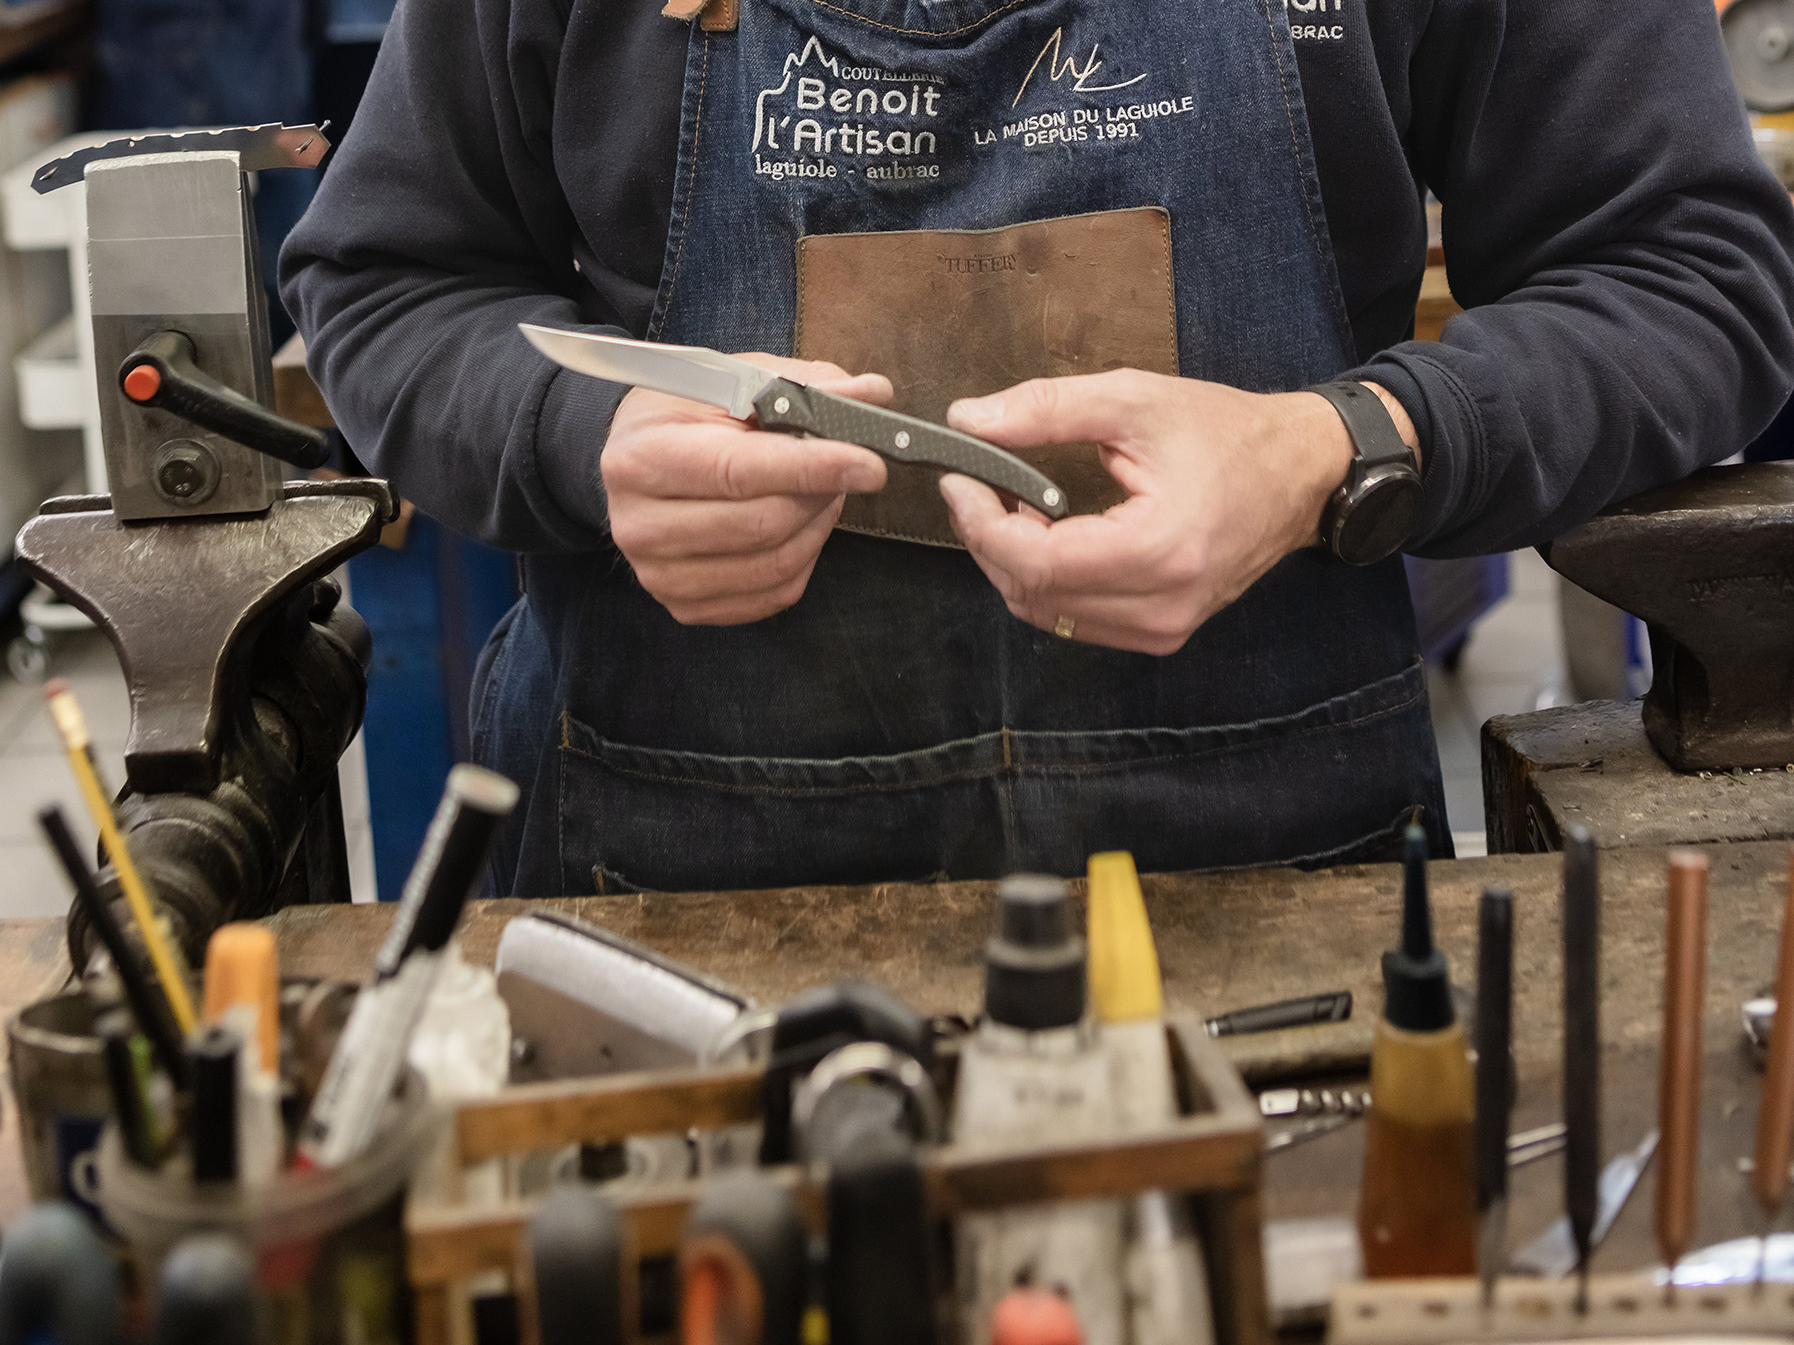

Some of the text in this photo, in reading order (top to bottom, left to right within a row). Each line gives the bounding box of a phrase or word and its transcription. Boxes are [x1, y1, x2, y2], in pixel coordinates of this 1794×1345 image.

[797, 77, 941, 117] Benoit
[768, 116, 936, 155] l'Artisan
[974, 96, 1194, 145] LA MAISON DU LAGUIOLE
[1023, 122, 1140, 147] DEPUIS 1991
[755, 154, 837, 180] laguiole
[866, 161, 940, 179] aubrac
